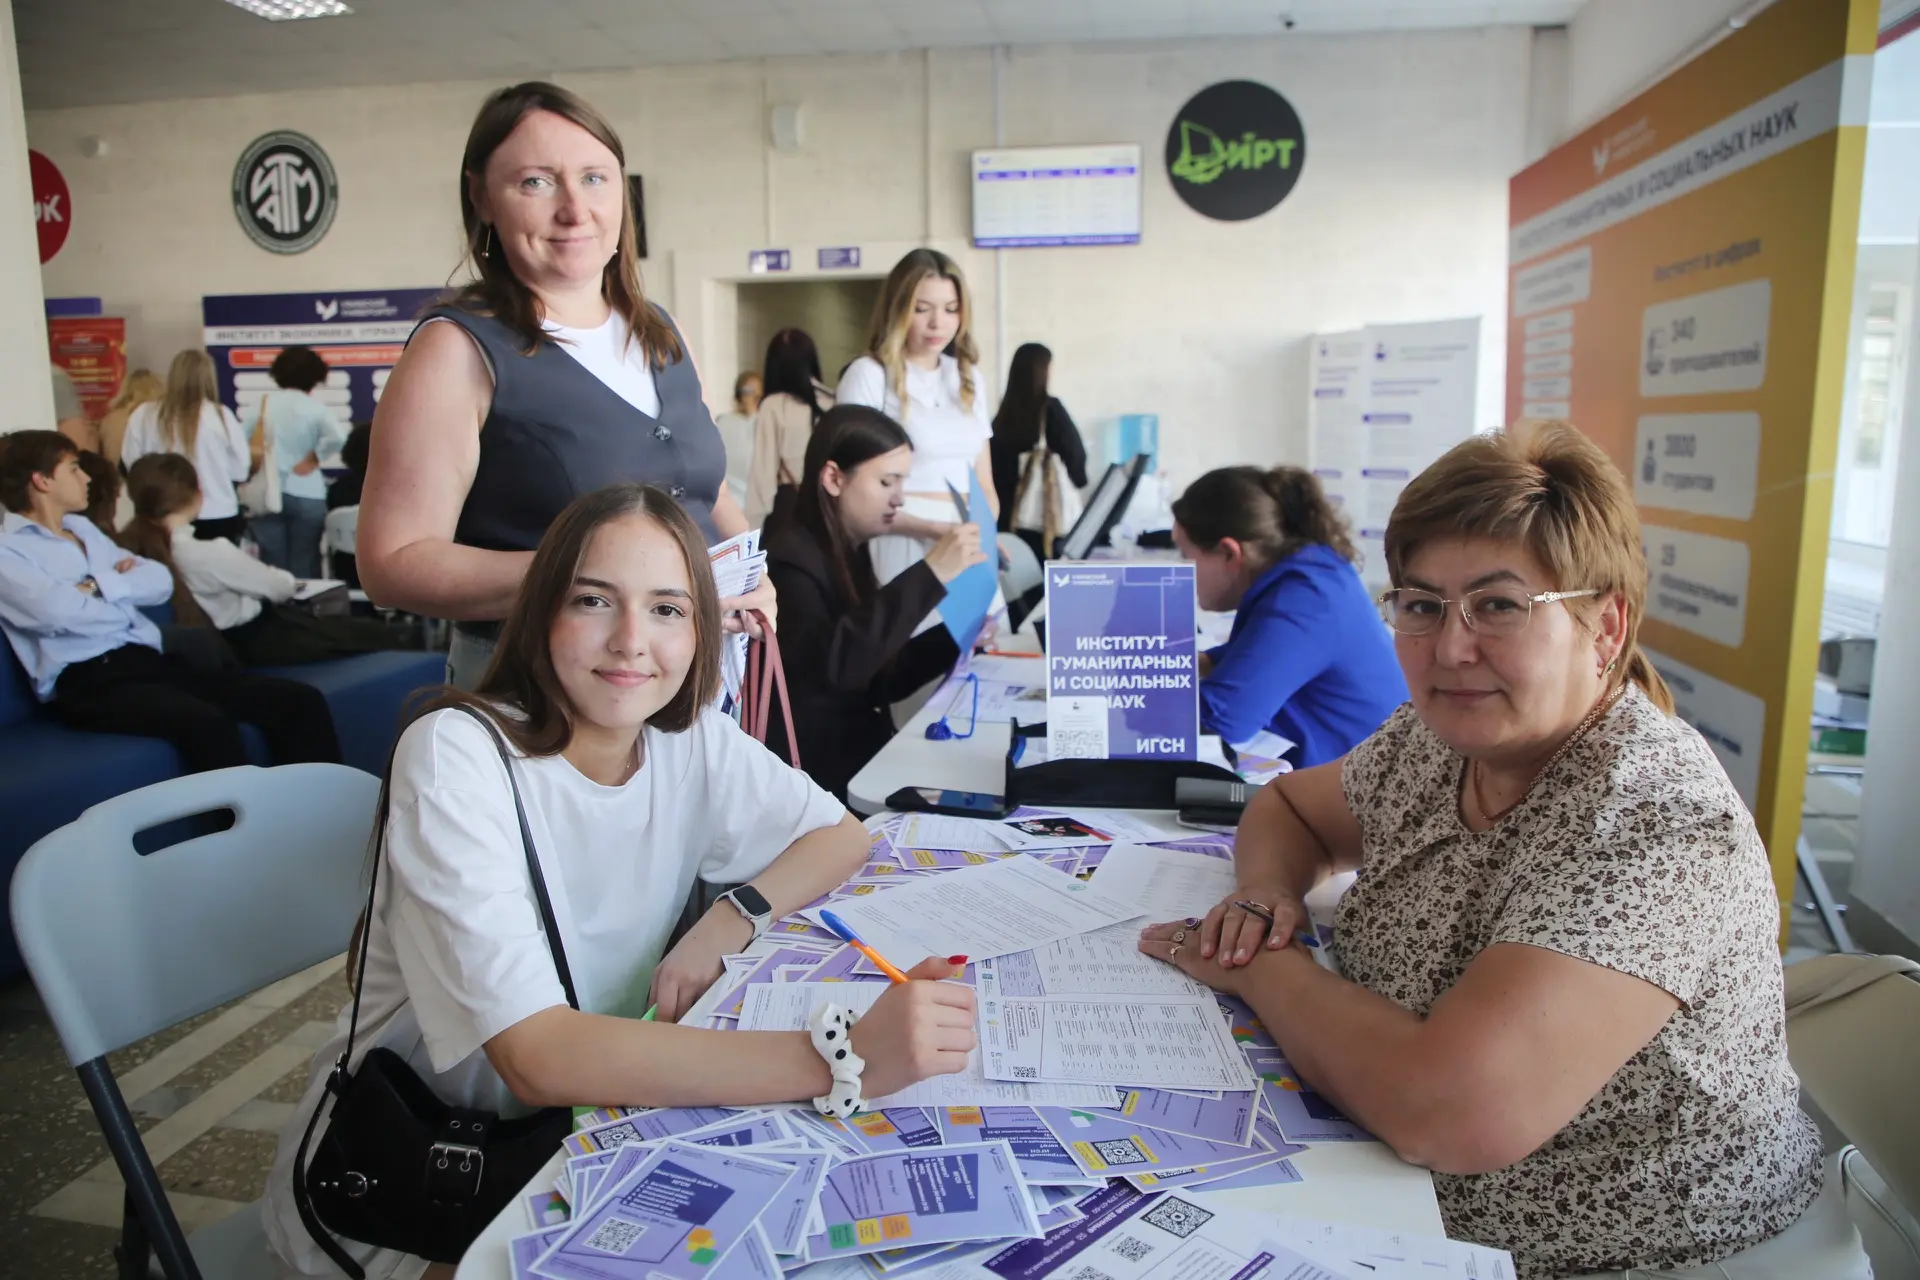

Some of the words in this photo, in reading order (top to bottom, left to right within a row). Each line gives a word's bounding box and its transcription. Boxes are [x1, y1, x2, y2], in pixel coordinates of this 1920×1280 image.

[1750, 100, 1799, 148] НАУК
[1076, 635, 1168, 651] ИНСТИТУТ
[1051, 655, 1193, 671] ГУМАНИТАРНЫХ
[1053, 676, 1066, 690] И
[1070, 674, 1192, 691] СОЦИАЛЬНЫХ
[1136, 738, 1186, 754] ИГСН
[671, 1179, 691, 1188] ИГСН
[1086, 1212, 1117, 1234] ДАННЫЕ
